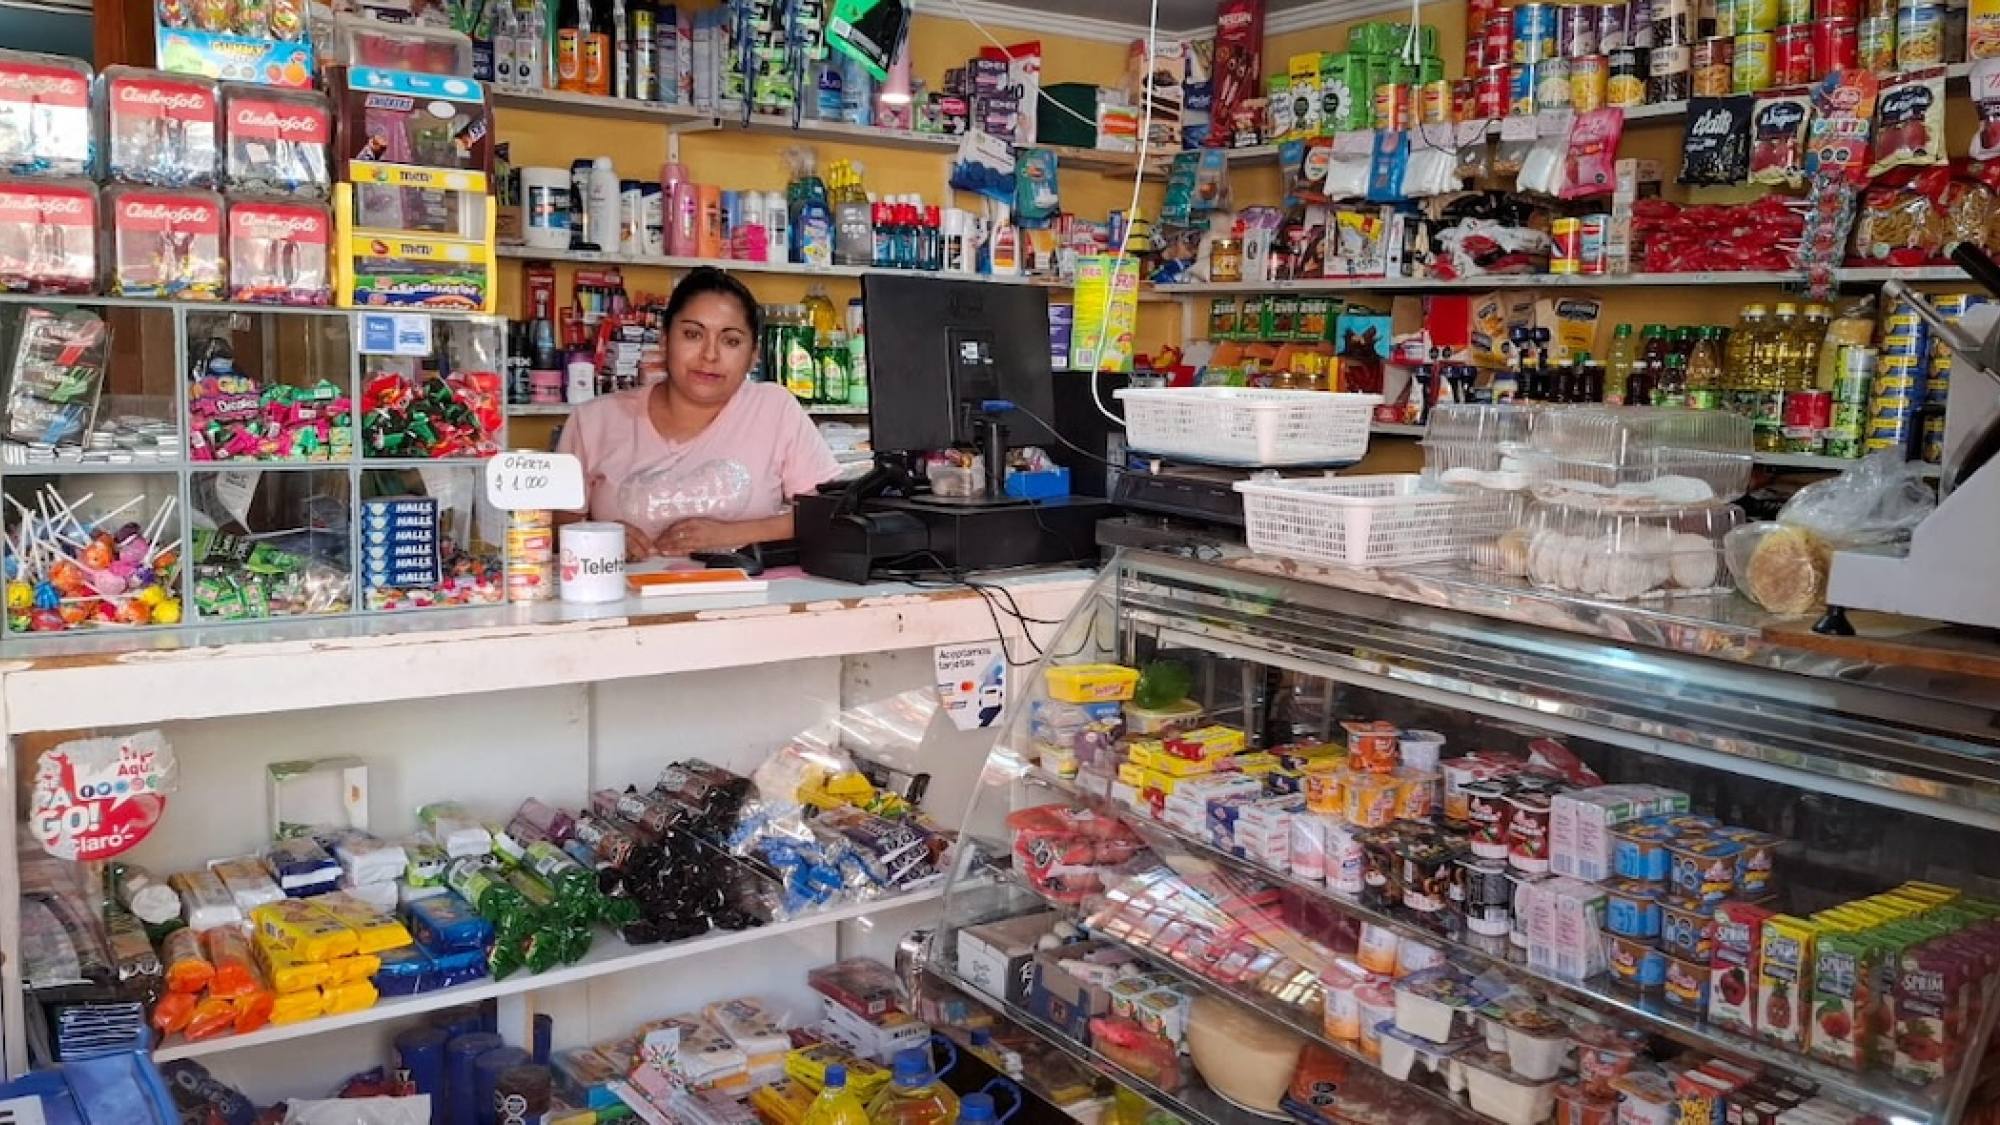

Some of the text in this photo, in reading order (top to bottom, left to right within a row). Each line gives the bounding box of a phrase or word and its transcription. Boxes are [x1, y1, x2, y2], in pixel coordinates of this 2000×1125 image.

[120, 86, 206, 110] Ambrosoli
[237, 109, 318, 132] Ambrosoli
[126, 202, 210, 224] Ambrosoli
[505, 457, 551, 470] OFERTA
[396, 503, 433, 513] HALLS
[396, 517, 433, 527] HALLS
[396, 531, 433, 541] HALLS
[396, 545, 433, 555] HALLS
[396, 558, 433, 568] HALLS
[396, 572, 433, 582] HALLS
[940, 647, 991, 658] Aceptamos
[939, 659, 975, 671] tarjetas
[35, 803, 100, 840] GO!
